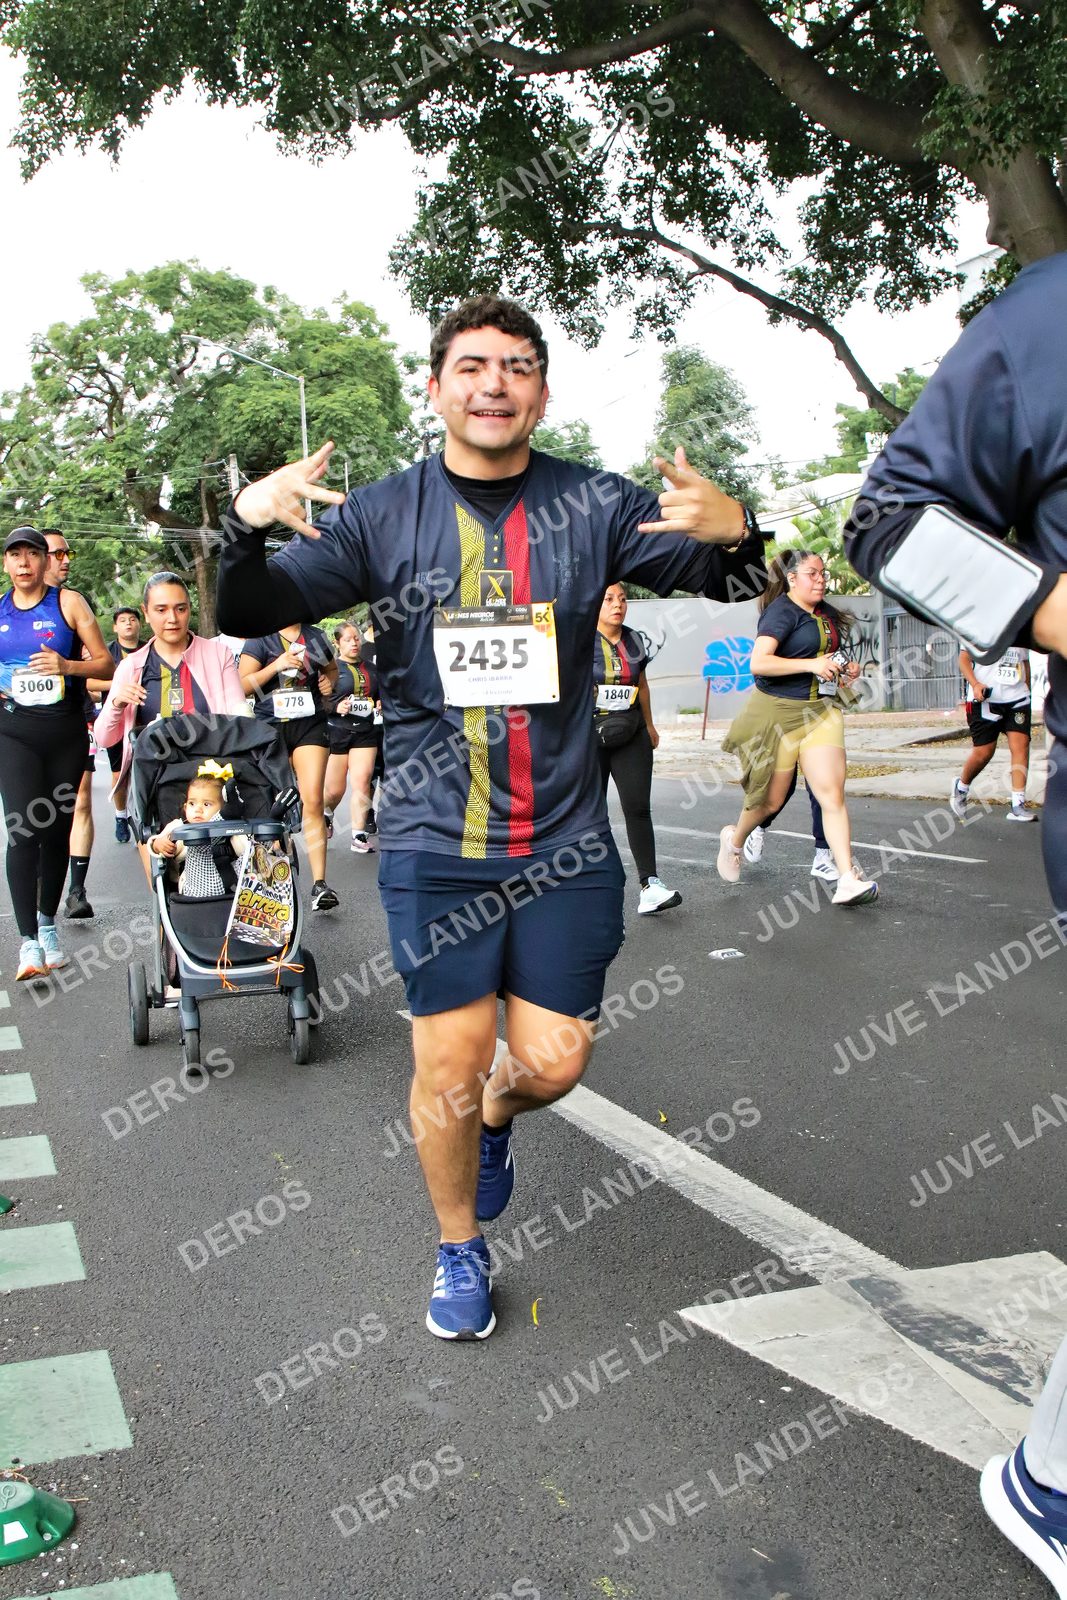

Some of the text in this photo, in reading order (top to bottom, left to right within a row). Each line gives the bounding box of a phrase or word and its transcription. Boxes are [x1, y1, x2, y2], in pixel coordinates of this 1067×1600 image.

[535, 612, 550, 623] 5K
[449, 638, 528, 672] 2435
[998, 668, 1016, 678] 3751
[19, 678, 53, 693] 3060
[604, 689, 630, 699] 1840
[284, 696, 304, 707] 778
[239, 888, 290, 921] arrera
